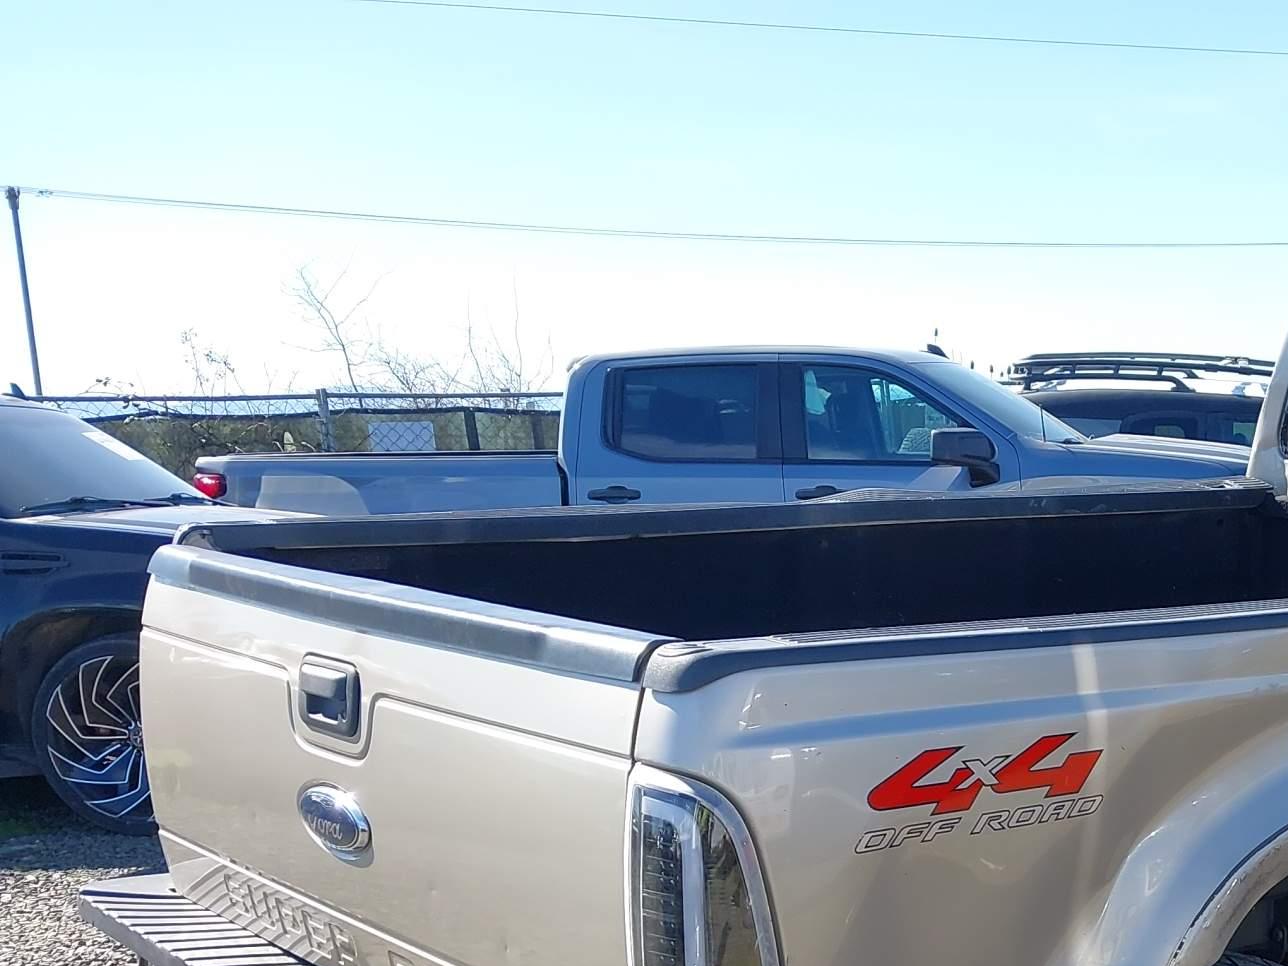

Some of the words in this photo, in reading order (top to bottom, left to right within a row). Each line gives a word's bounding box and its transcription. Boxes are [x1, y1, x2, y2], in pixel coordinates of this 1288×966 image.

[306, 813, 343, 841] Ford
[854, 815, 963, 855] OFF
[969, 794, 1105, 836] ROAD
